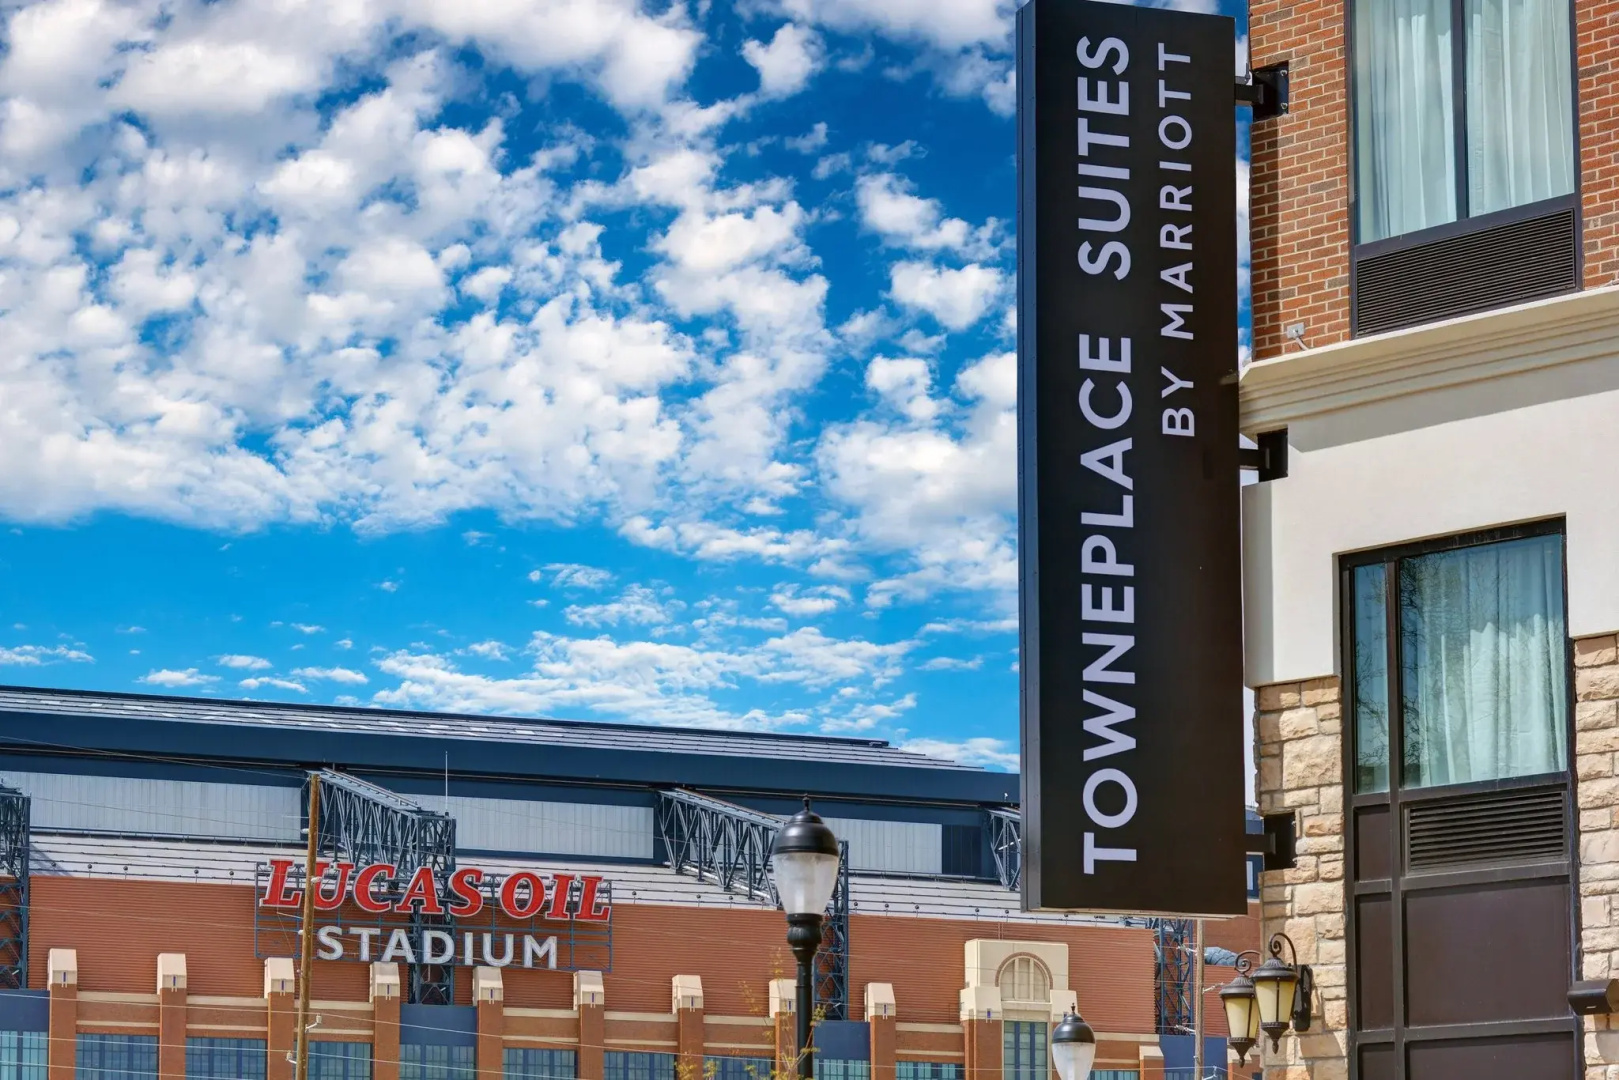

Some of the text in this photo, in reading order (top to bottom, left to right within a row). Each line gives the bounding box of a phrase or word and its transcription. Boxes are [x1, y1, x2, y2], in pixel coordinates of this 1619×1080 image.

[1158, 42, 1195, 437] BY MARRIOTT
[1076, 36, 1138, 875] TOWNEPLACE SUITES
[259, 859, 612, 922] LUCAS OIL
[317, 926, 557, 969] STADIUM
